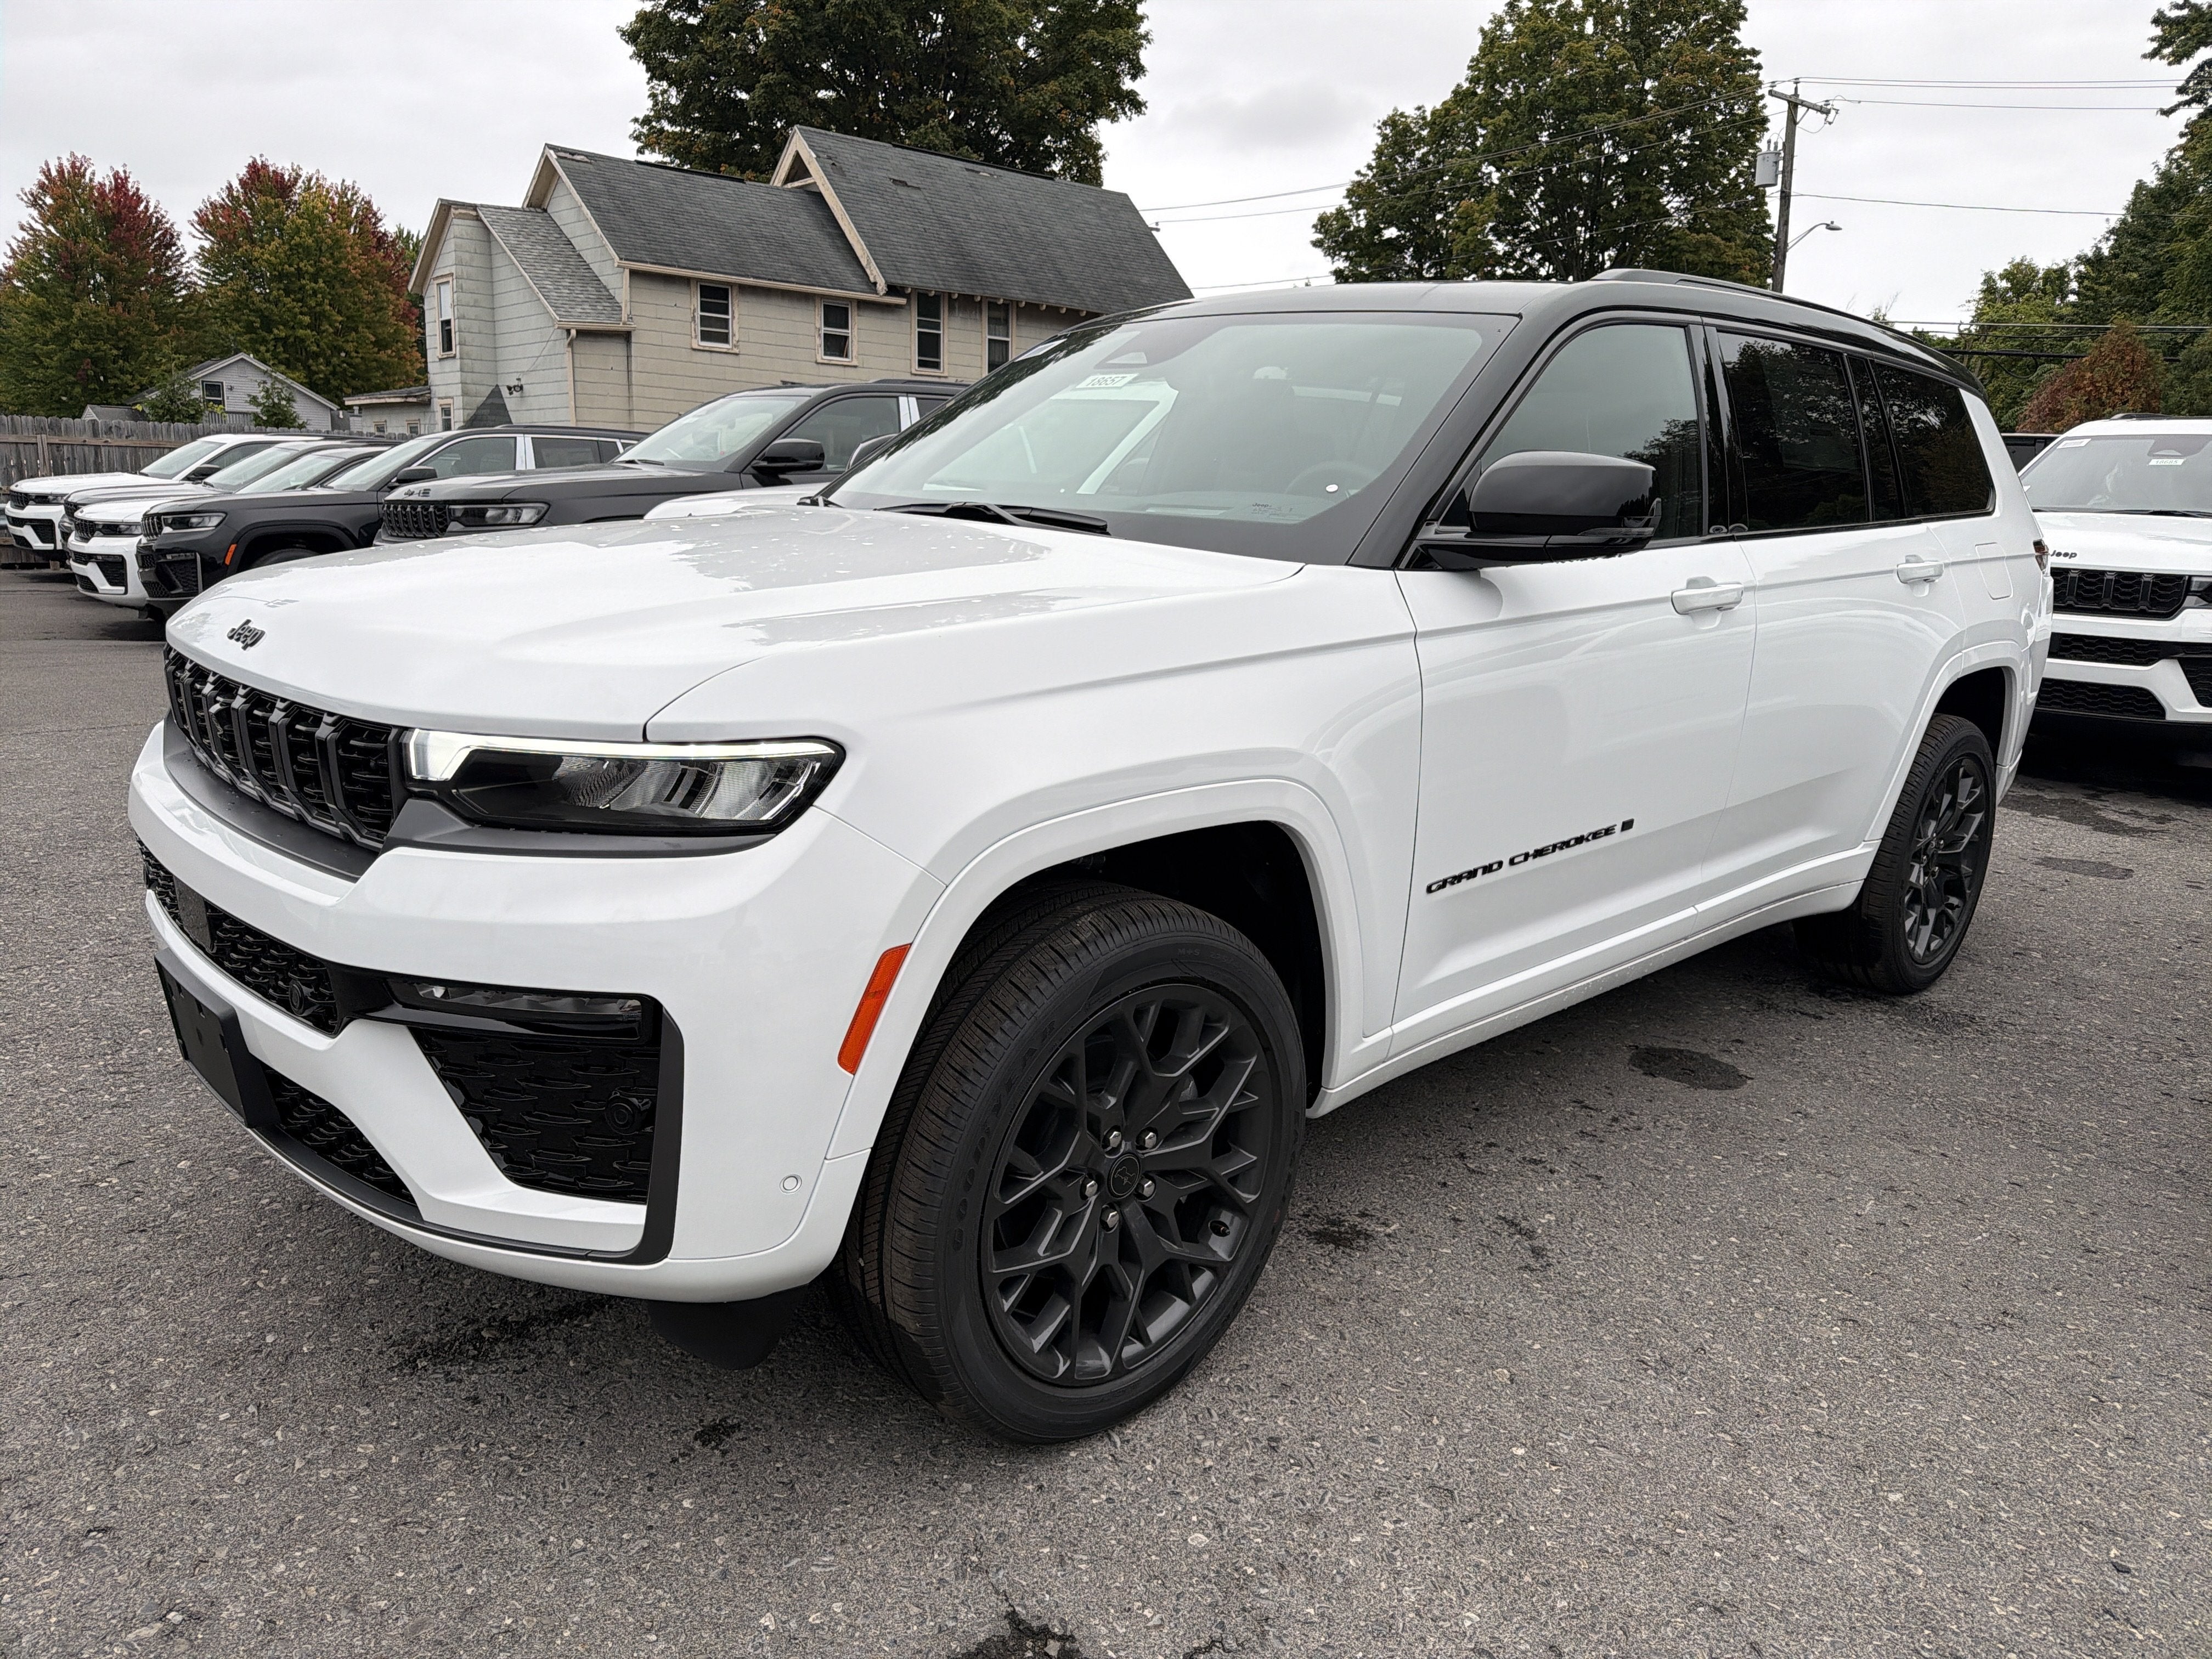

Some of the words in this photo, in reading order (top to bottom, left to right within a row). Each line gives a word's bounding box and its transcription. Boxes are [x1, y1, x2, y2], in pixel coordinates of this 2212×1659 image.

[1086, 376, 1127, 386] 18657
[2050, 550, 2077, 559] Jeep
[227, 619, 266, 651] Jeep
[1426, 860, 1504, 894] GRAND
[1509, 824, 1617, 866] CHEROKEE
[951, 1019, 1056, 1253] GOODYEAR
